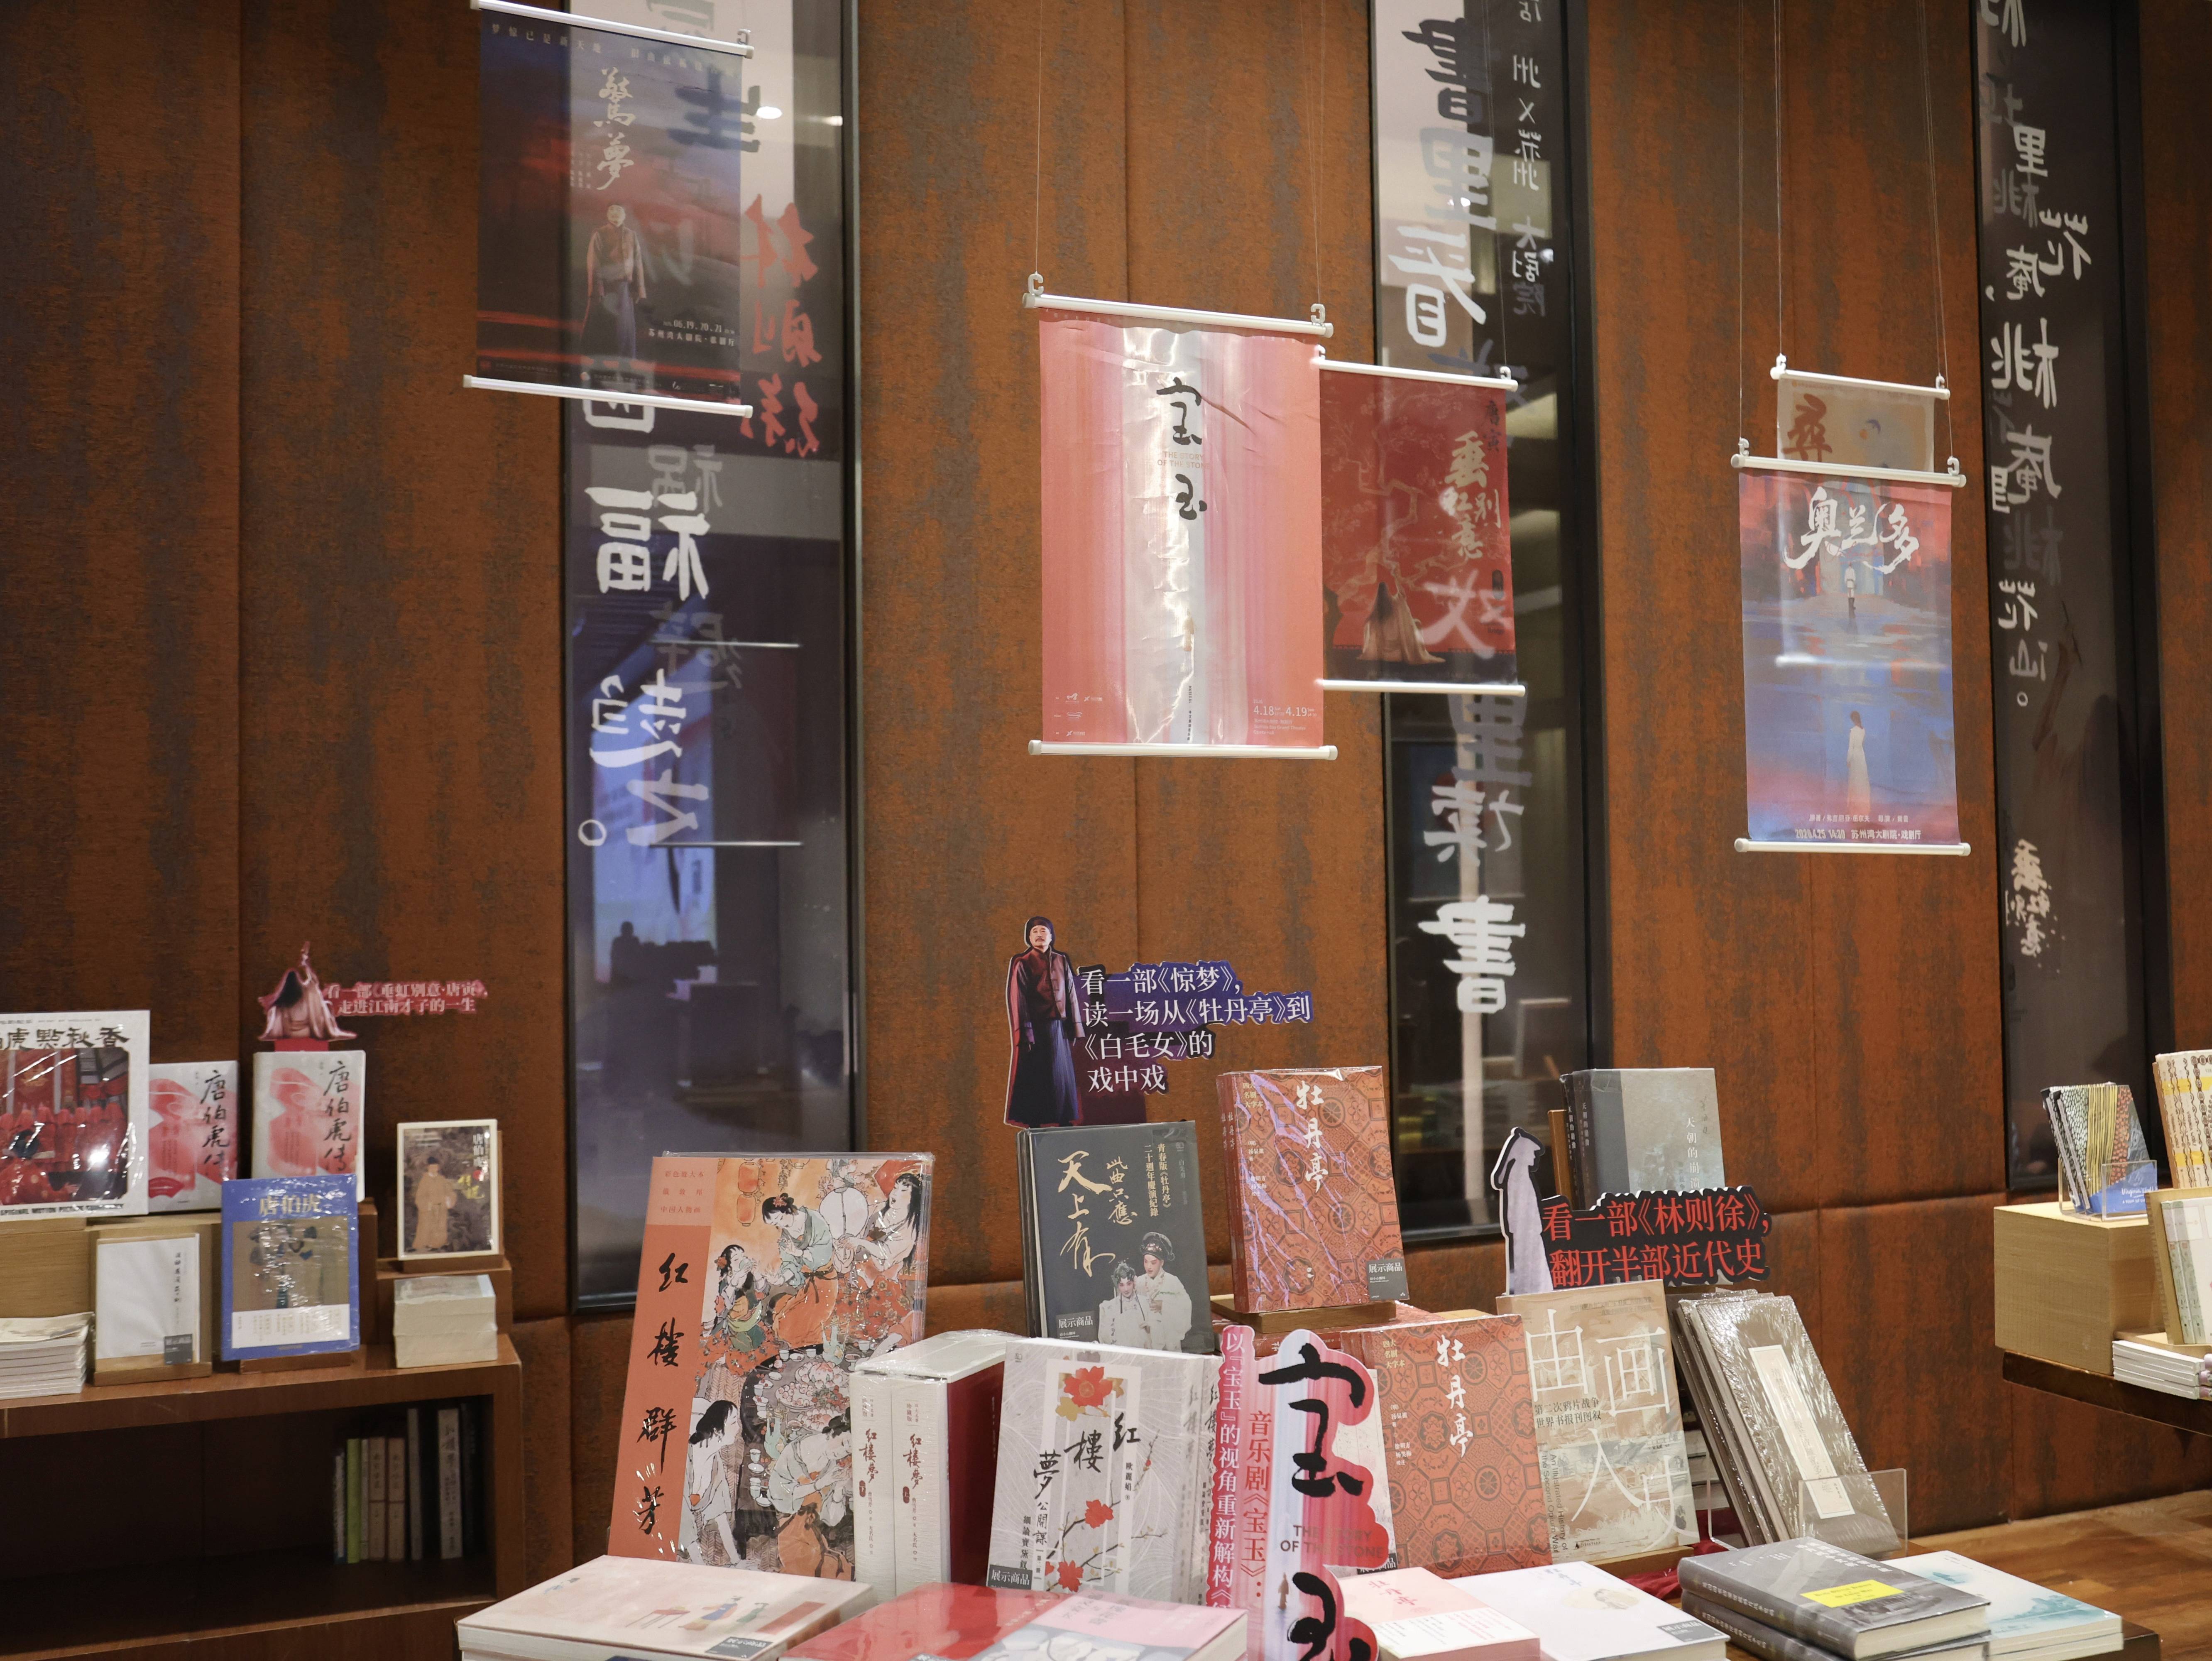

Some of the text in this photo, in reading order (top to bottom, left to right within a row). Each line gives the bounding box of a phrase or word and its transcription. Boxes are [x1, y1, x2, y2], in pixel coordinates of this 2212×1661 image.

[1180, 452, 1204, 461] STORY
[1783, 486, 1919, 574] 奥兰多
[1253, 706, 1274, 716] 4.18
[1285, 707, 1307, 717] 4.19
[1082, 995, 1311, 1028] 读一场从《牡丹亭》到
[1084, 1030, 1213, 1061] 《白毛女》的
[1087, 1065, 1166, 1093] 戏中戏
[1295, 1080, 1329, 1193] 牡丹亭
[1157, 1143, 1171, 1208] 青春版《牡丹亭》
[258, 1193, 322, 1217] 唐伯虎
[1368, 1262, 1403, 1274] 展示商品
[1549, 1238, 1764, 1287] 翻开半部近代史
[1058, 1314, 1094, 1330] 展示商品
[1382, 1340, 1396, 1348] 四大
[1385, 1360, 1405, 1369] 大字本
[1436, 1334, 1474, 1459] 牡丹亭
[1534, 1399, 1600, 1416] 第二次鸦片战争
[1536, 1410, 1601, 1428] 世界书报刊图叙
[1543, 1470, 1552, 1503] Second
[1550, 1454, 1568, 1551] An Illustrated History of
[1547, 1504, 1556, 1533] Opium
[1293, 1525, 1319, 1538] THE
[1280, 1540, 1299, 1552] OF
[1335, 1543, 1384, 1559] STONE
[991, 1569, 1030, 1586] 展示商品
